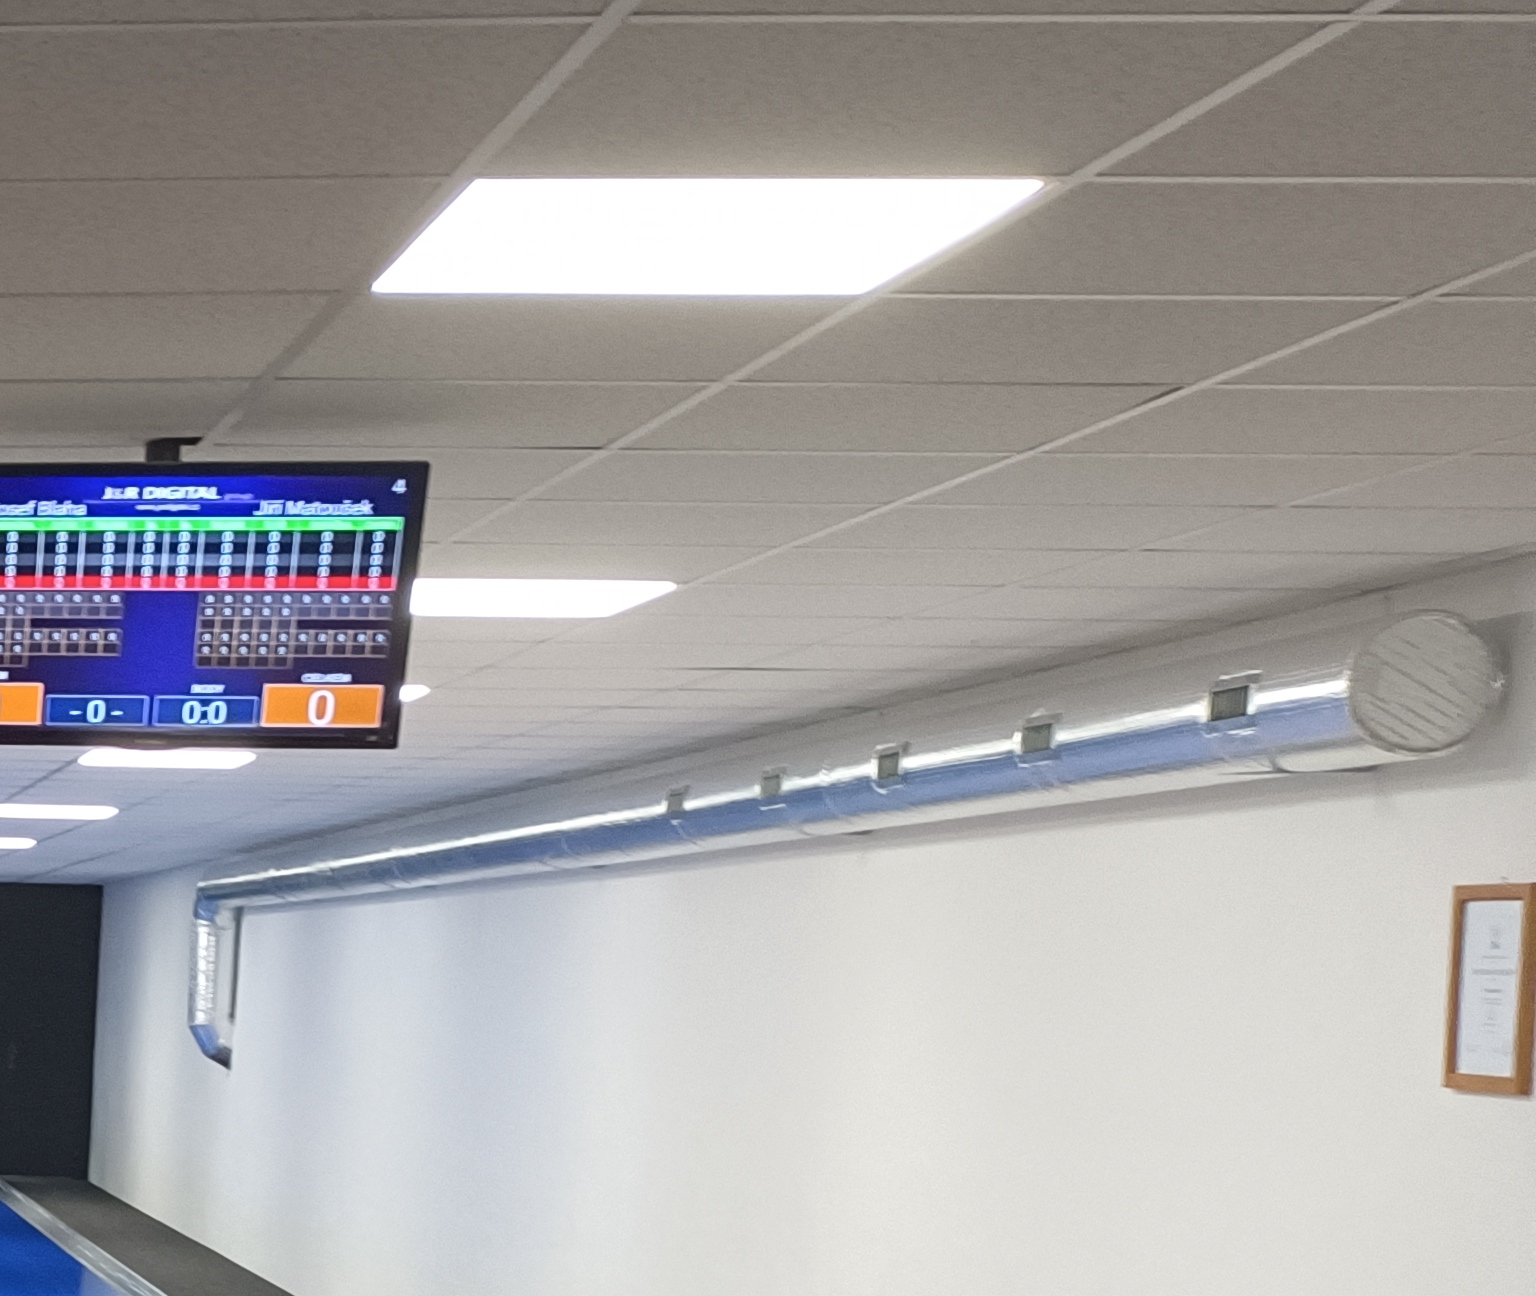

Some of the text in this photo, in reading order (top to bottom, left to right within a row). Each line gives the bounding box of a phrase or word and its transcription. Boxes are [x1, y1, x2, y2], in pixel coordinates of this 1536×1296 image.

[142, 486, 223, 500] DIGITAL
[391, 478, 407, 494] 4
[307, 689, 336, 725] 0
